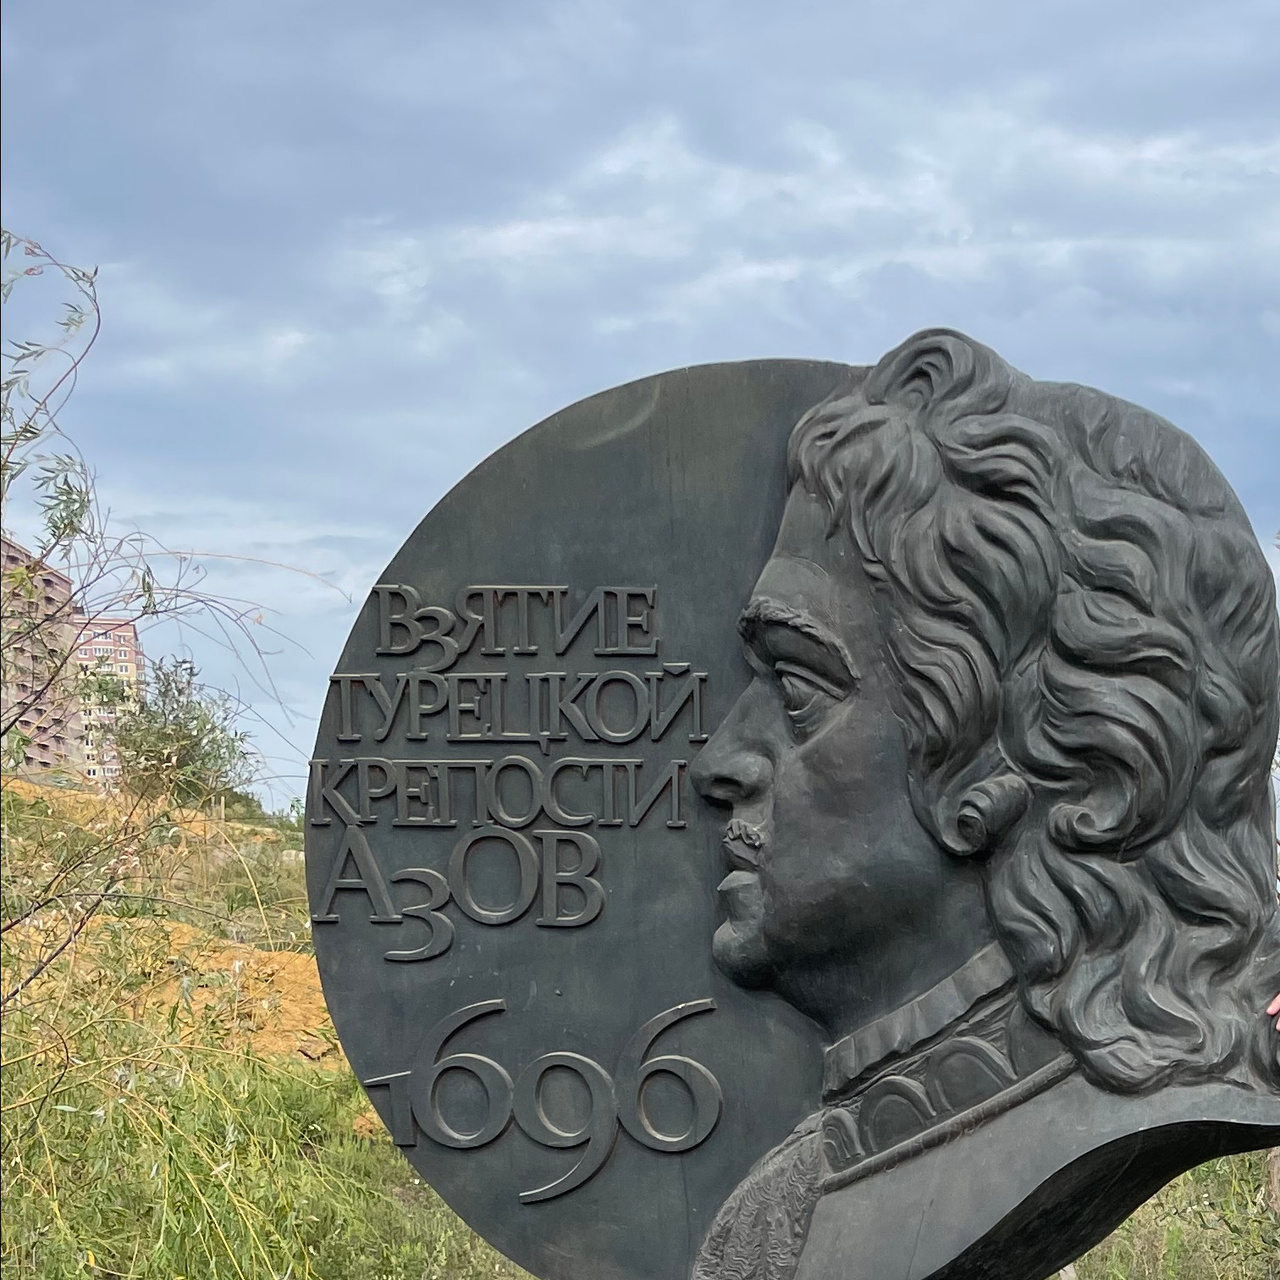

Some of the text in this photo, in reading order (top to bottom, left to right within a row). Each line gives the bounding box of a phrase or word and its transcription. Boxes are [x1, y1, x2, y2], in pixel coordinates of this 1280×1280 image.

[374, 584, 661, 672] ВЗЯТИЕ
[330, 662, 709, 756] ТУРЕЦКОЙ
[309, 755, 688, 829] КРЕПОСТИ
[312, 823, 605, 962] АЗОВ
[364, 998, 723, 1204] 1696
